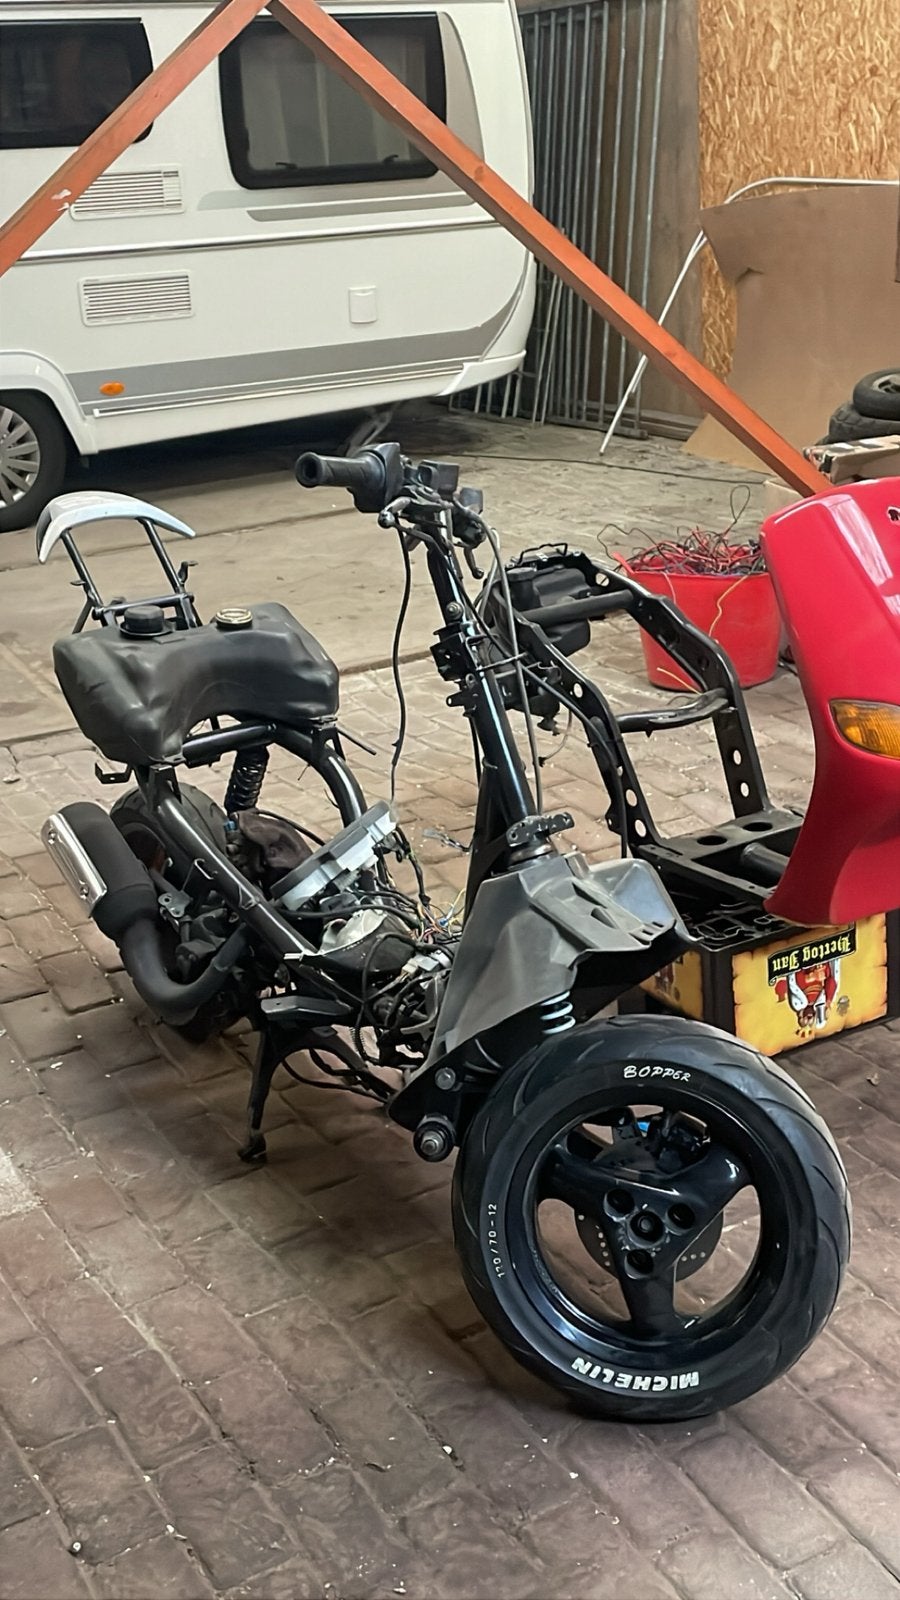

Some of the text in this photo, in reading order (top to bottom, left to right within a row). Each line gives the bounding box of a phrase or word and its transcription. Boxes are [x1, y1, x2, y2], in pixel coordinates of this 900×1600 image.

[772, 933, 852, 971] Hertog Jan
[623, 1065, 691, 1082] BOPPER
[571, 1357, 699, 1391] MICHELIN
